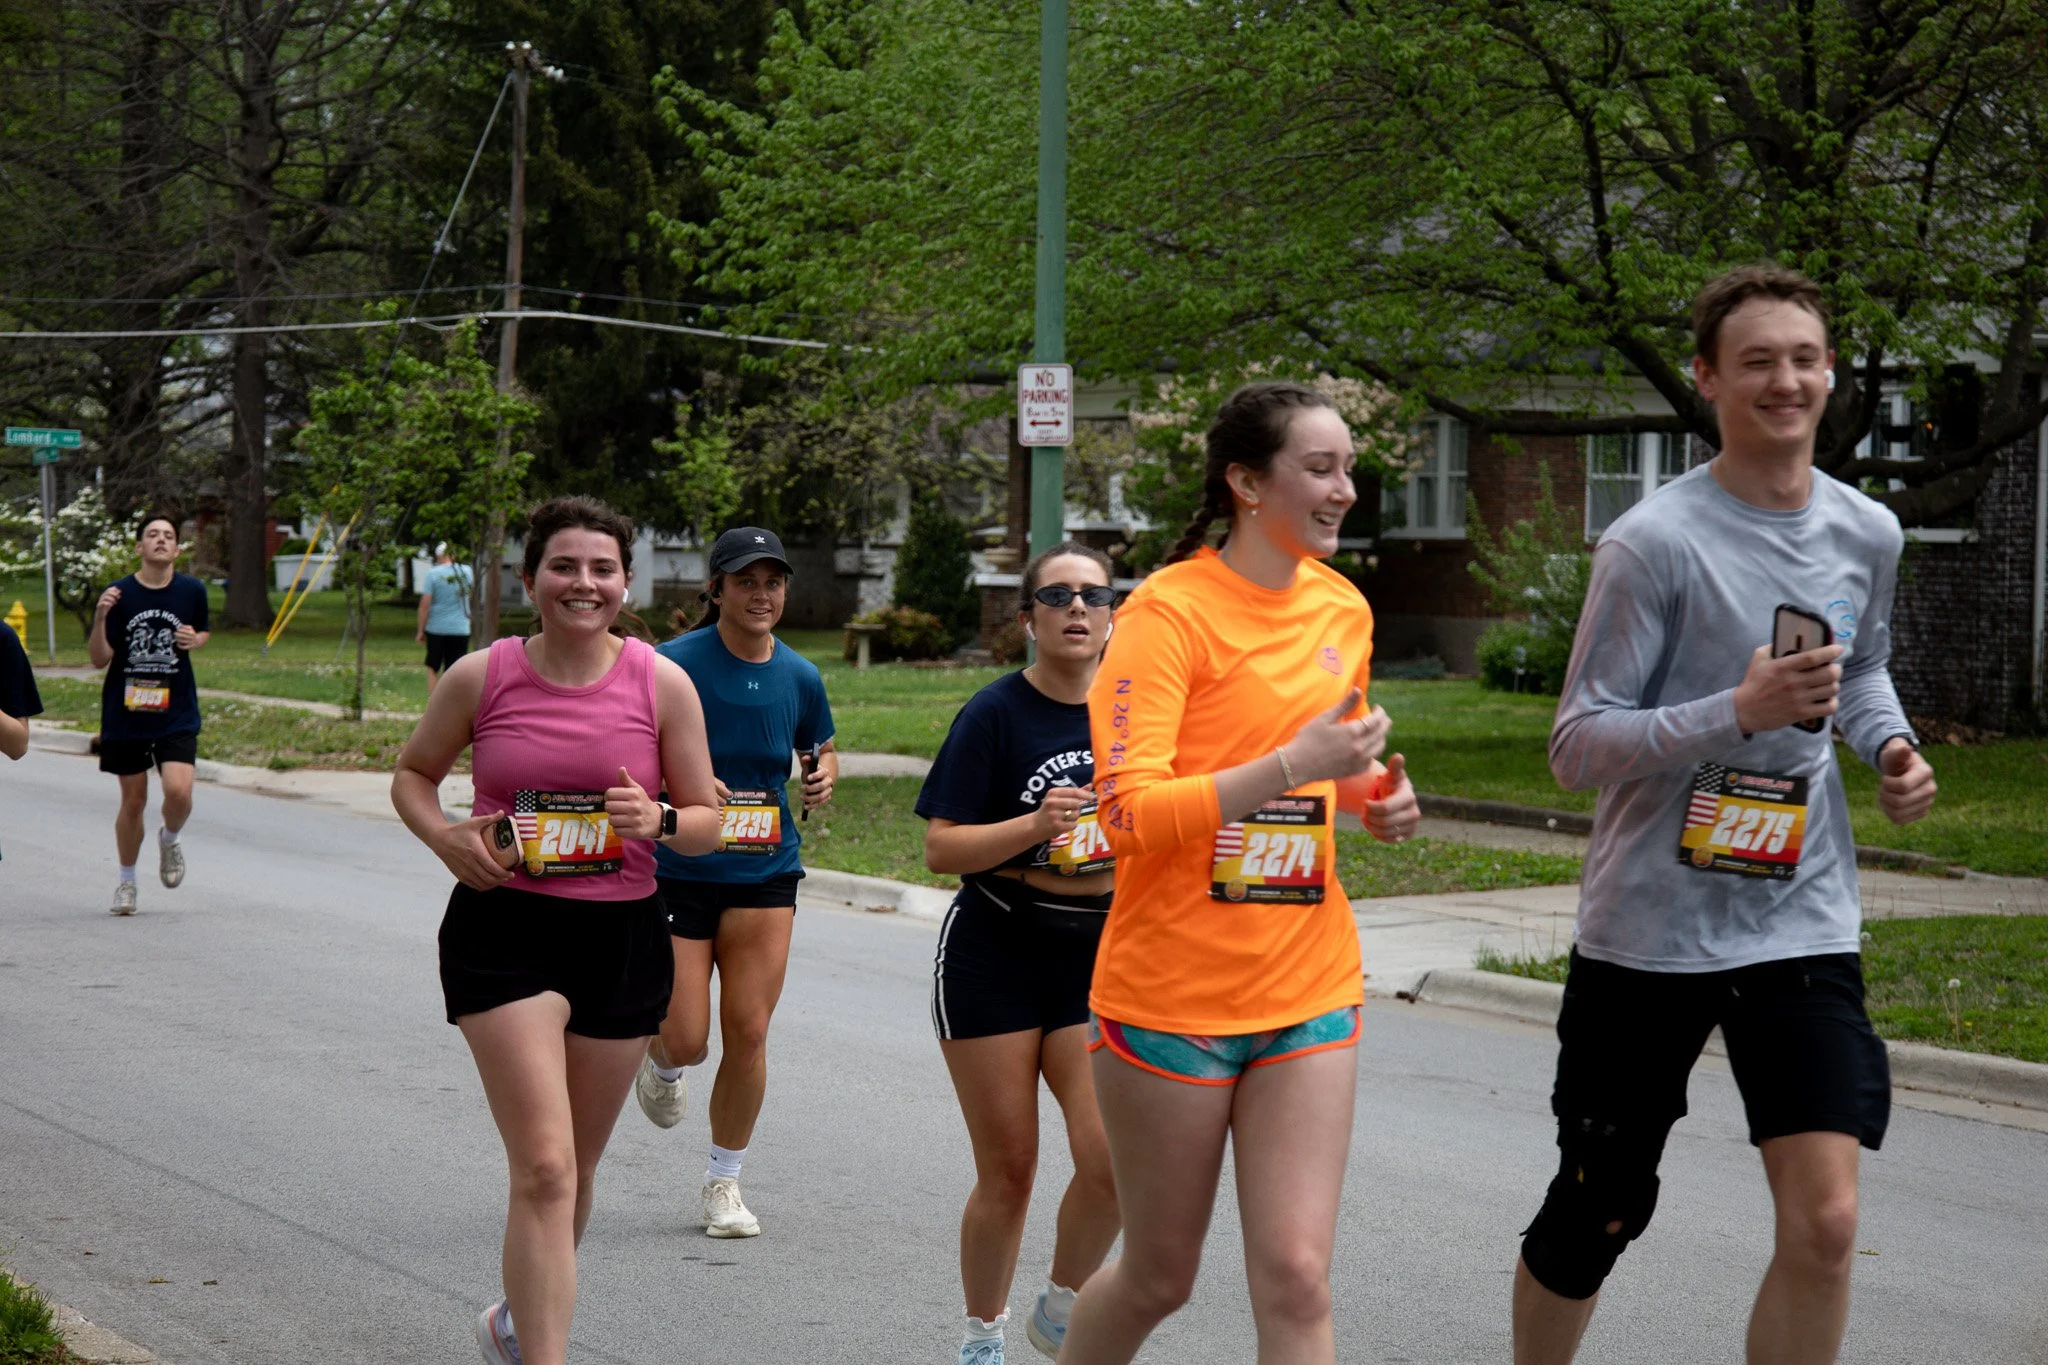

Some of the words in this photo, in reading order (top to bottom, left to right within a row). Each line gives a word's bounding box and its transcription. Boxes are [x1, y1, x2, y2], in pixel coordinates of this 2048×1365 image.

[1035, 372, 1056, 387] NO
[1022, 389, 1068, 404] PARKING
[126, 608, 160, 632] POTTER'S
[161, 610, 184, 630] HOUS
[1115, 679, 1132, 695] N
[1020, 750, 1095, 806] POTTER'S
[540, 818, 610, 856] 2041
[720, 810, 773, 839] 2239
[1070, 820, 1112, 859] 214
[1708, 804, 1797, 855] 2275
[1240, 831, 1318, 879] 2274
